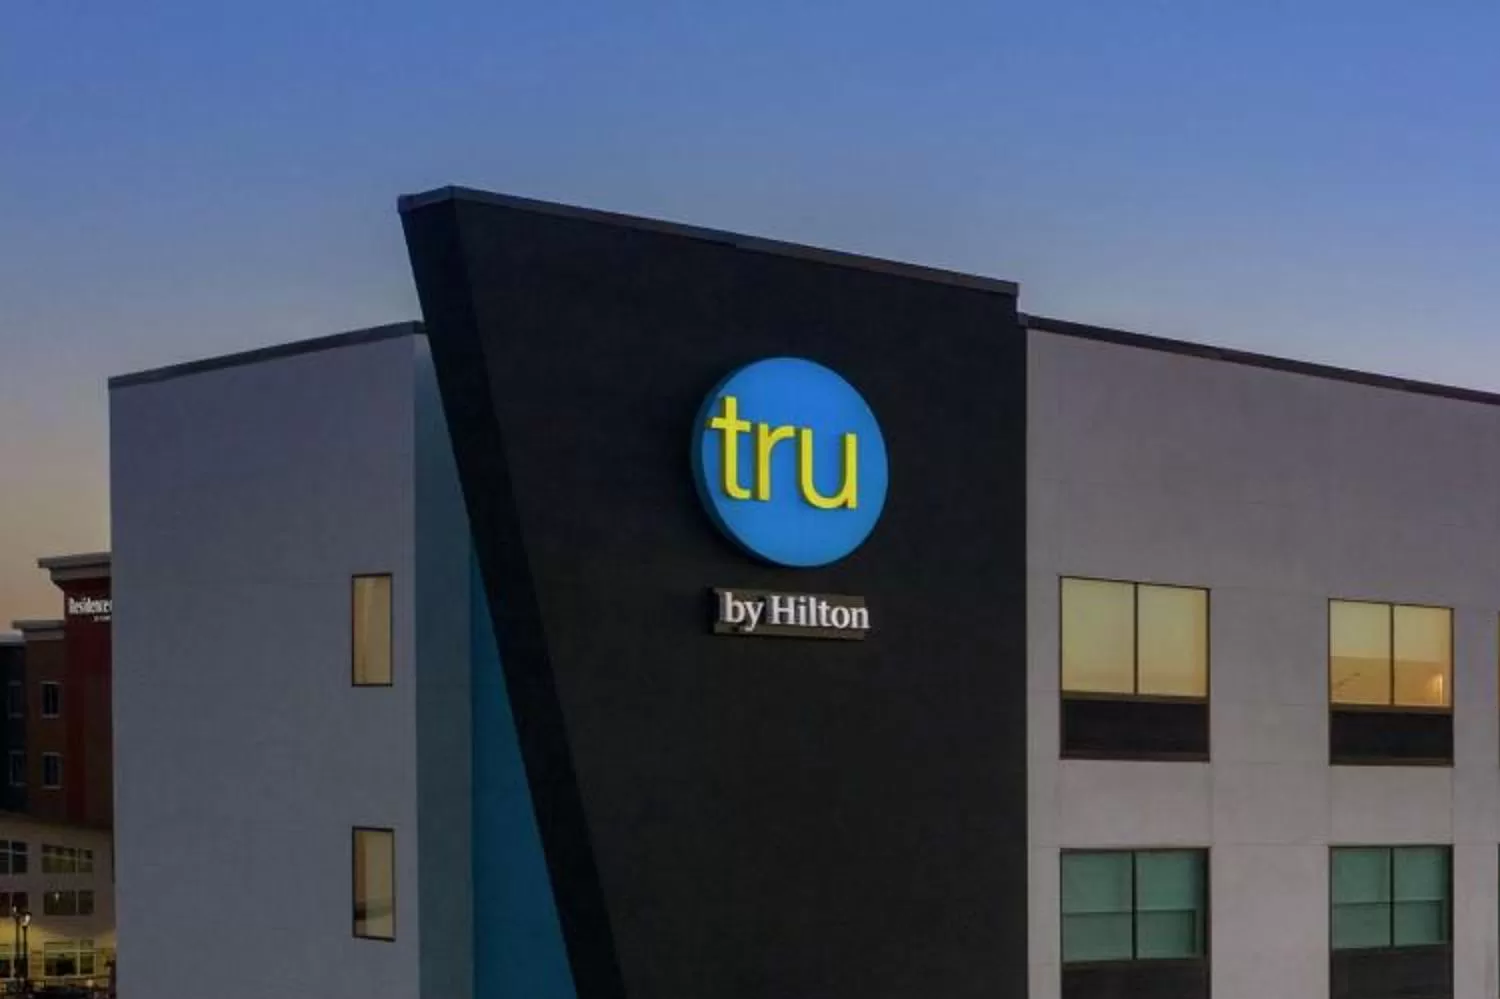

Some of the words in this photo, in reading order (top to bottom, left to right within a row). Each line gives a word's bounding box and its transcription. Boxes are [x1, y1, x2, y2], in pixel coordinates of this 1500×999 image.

[709, 396, 858, 509] tru
[724, 591, 763, 632] by
[770, 596, 870, 630] Hilton
